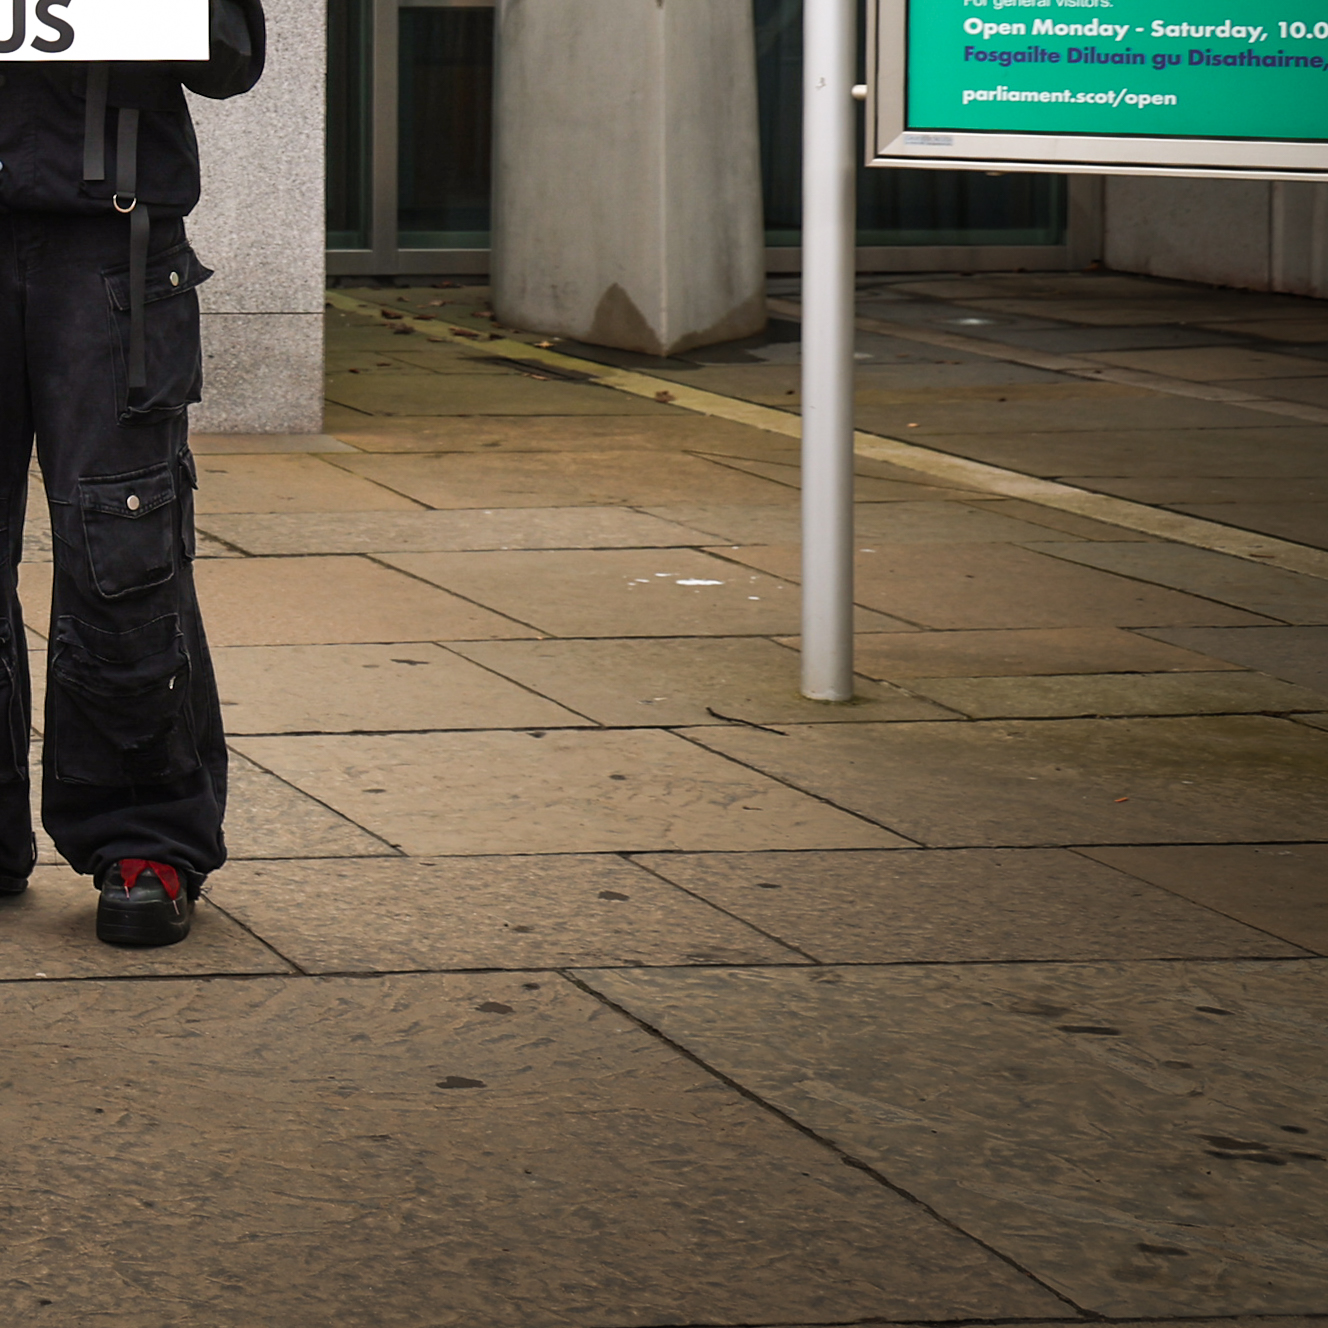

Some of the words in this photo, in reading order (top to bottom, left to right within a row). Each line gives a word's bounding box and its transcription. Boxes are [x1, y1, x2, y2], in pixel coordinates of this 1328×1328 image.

[963, 17, 1027, 40] Open
[1031, 17, 1129, 42] Monday
[1150, 19, 1268, 44] Saturday,
[1277, 20, 1328, 40] 10.0
[964, 45, 1061, 68] Fosgailte
[1067, 45, 1146, 66] Diluain
[1151, 51, 1182, 71] gu
[961, 84, 1177, 110] parliament.scot/open
